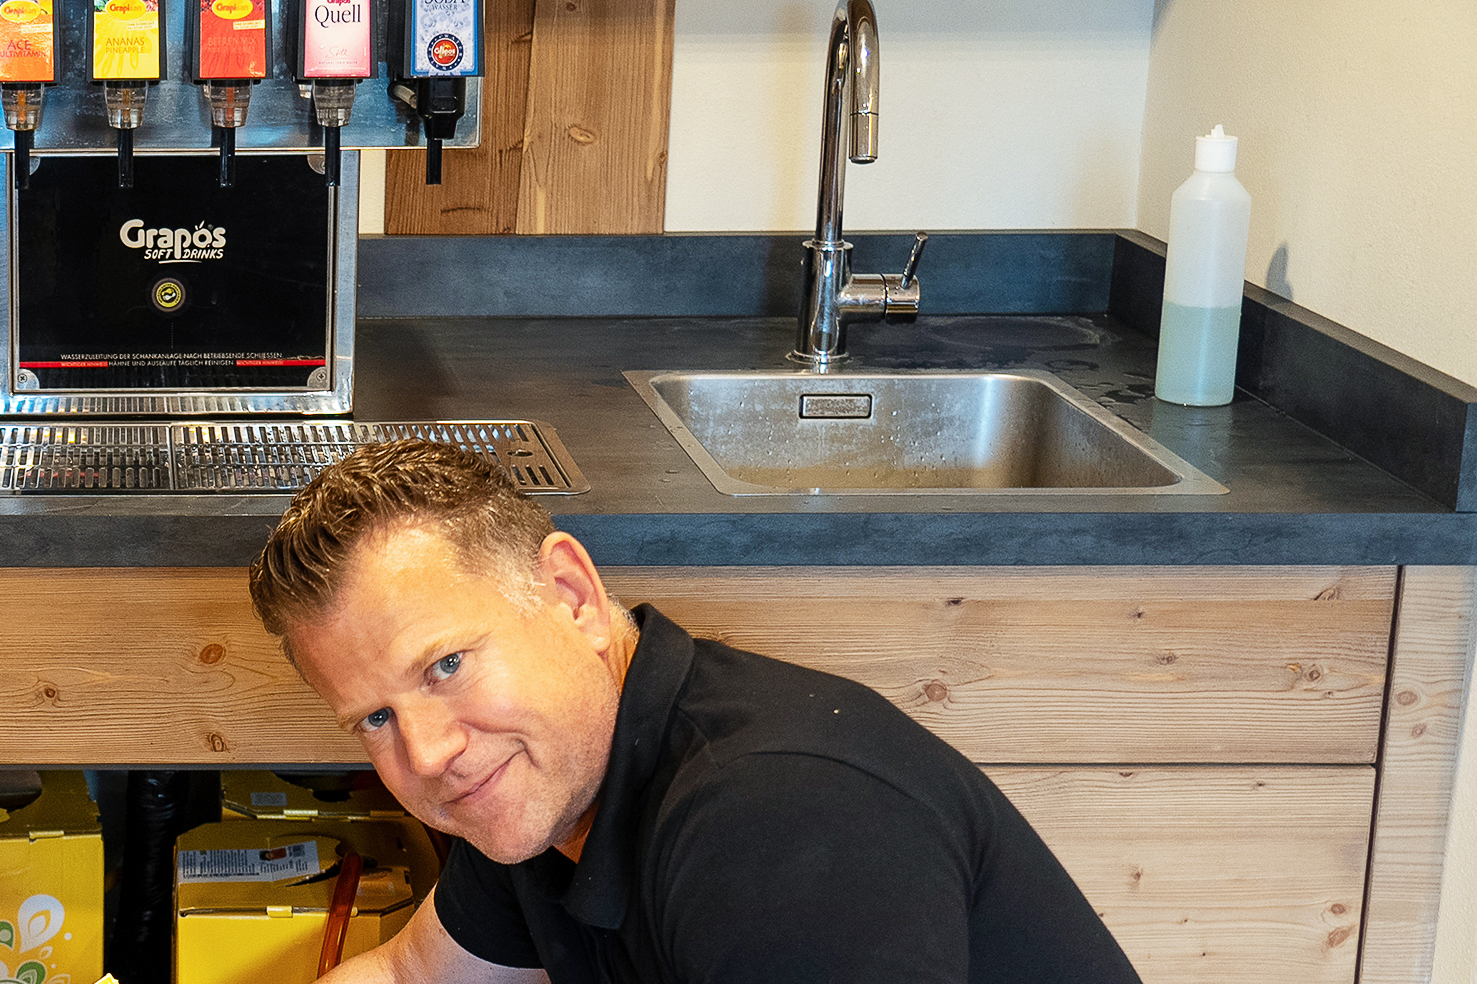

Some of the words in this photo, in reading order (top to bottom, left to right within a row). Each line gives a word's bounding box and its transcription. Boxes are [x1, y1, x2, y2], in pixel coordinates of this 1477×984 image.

[314, 4, 361, 28] Quell
[6, 39, 33, 51] ACE
[105, 37, 145, 46] ANANAS
[105, 46, 146, 54] PINEAPPLE
[119, 219, 227, 259] Grapos
[144, 249, 173, 259] SOFT
[182, 249, 224, 259] DRINKS
